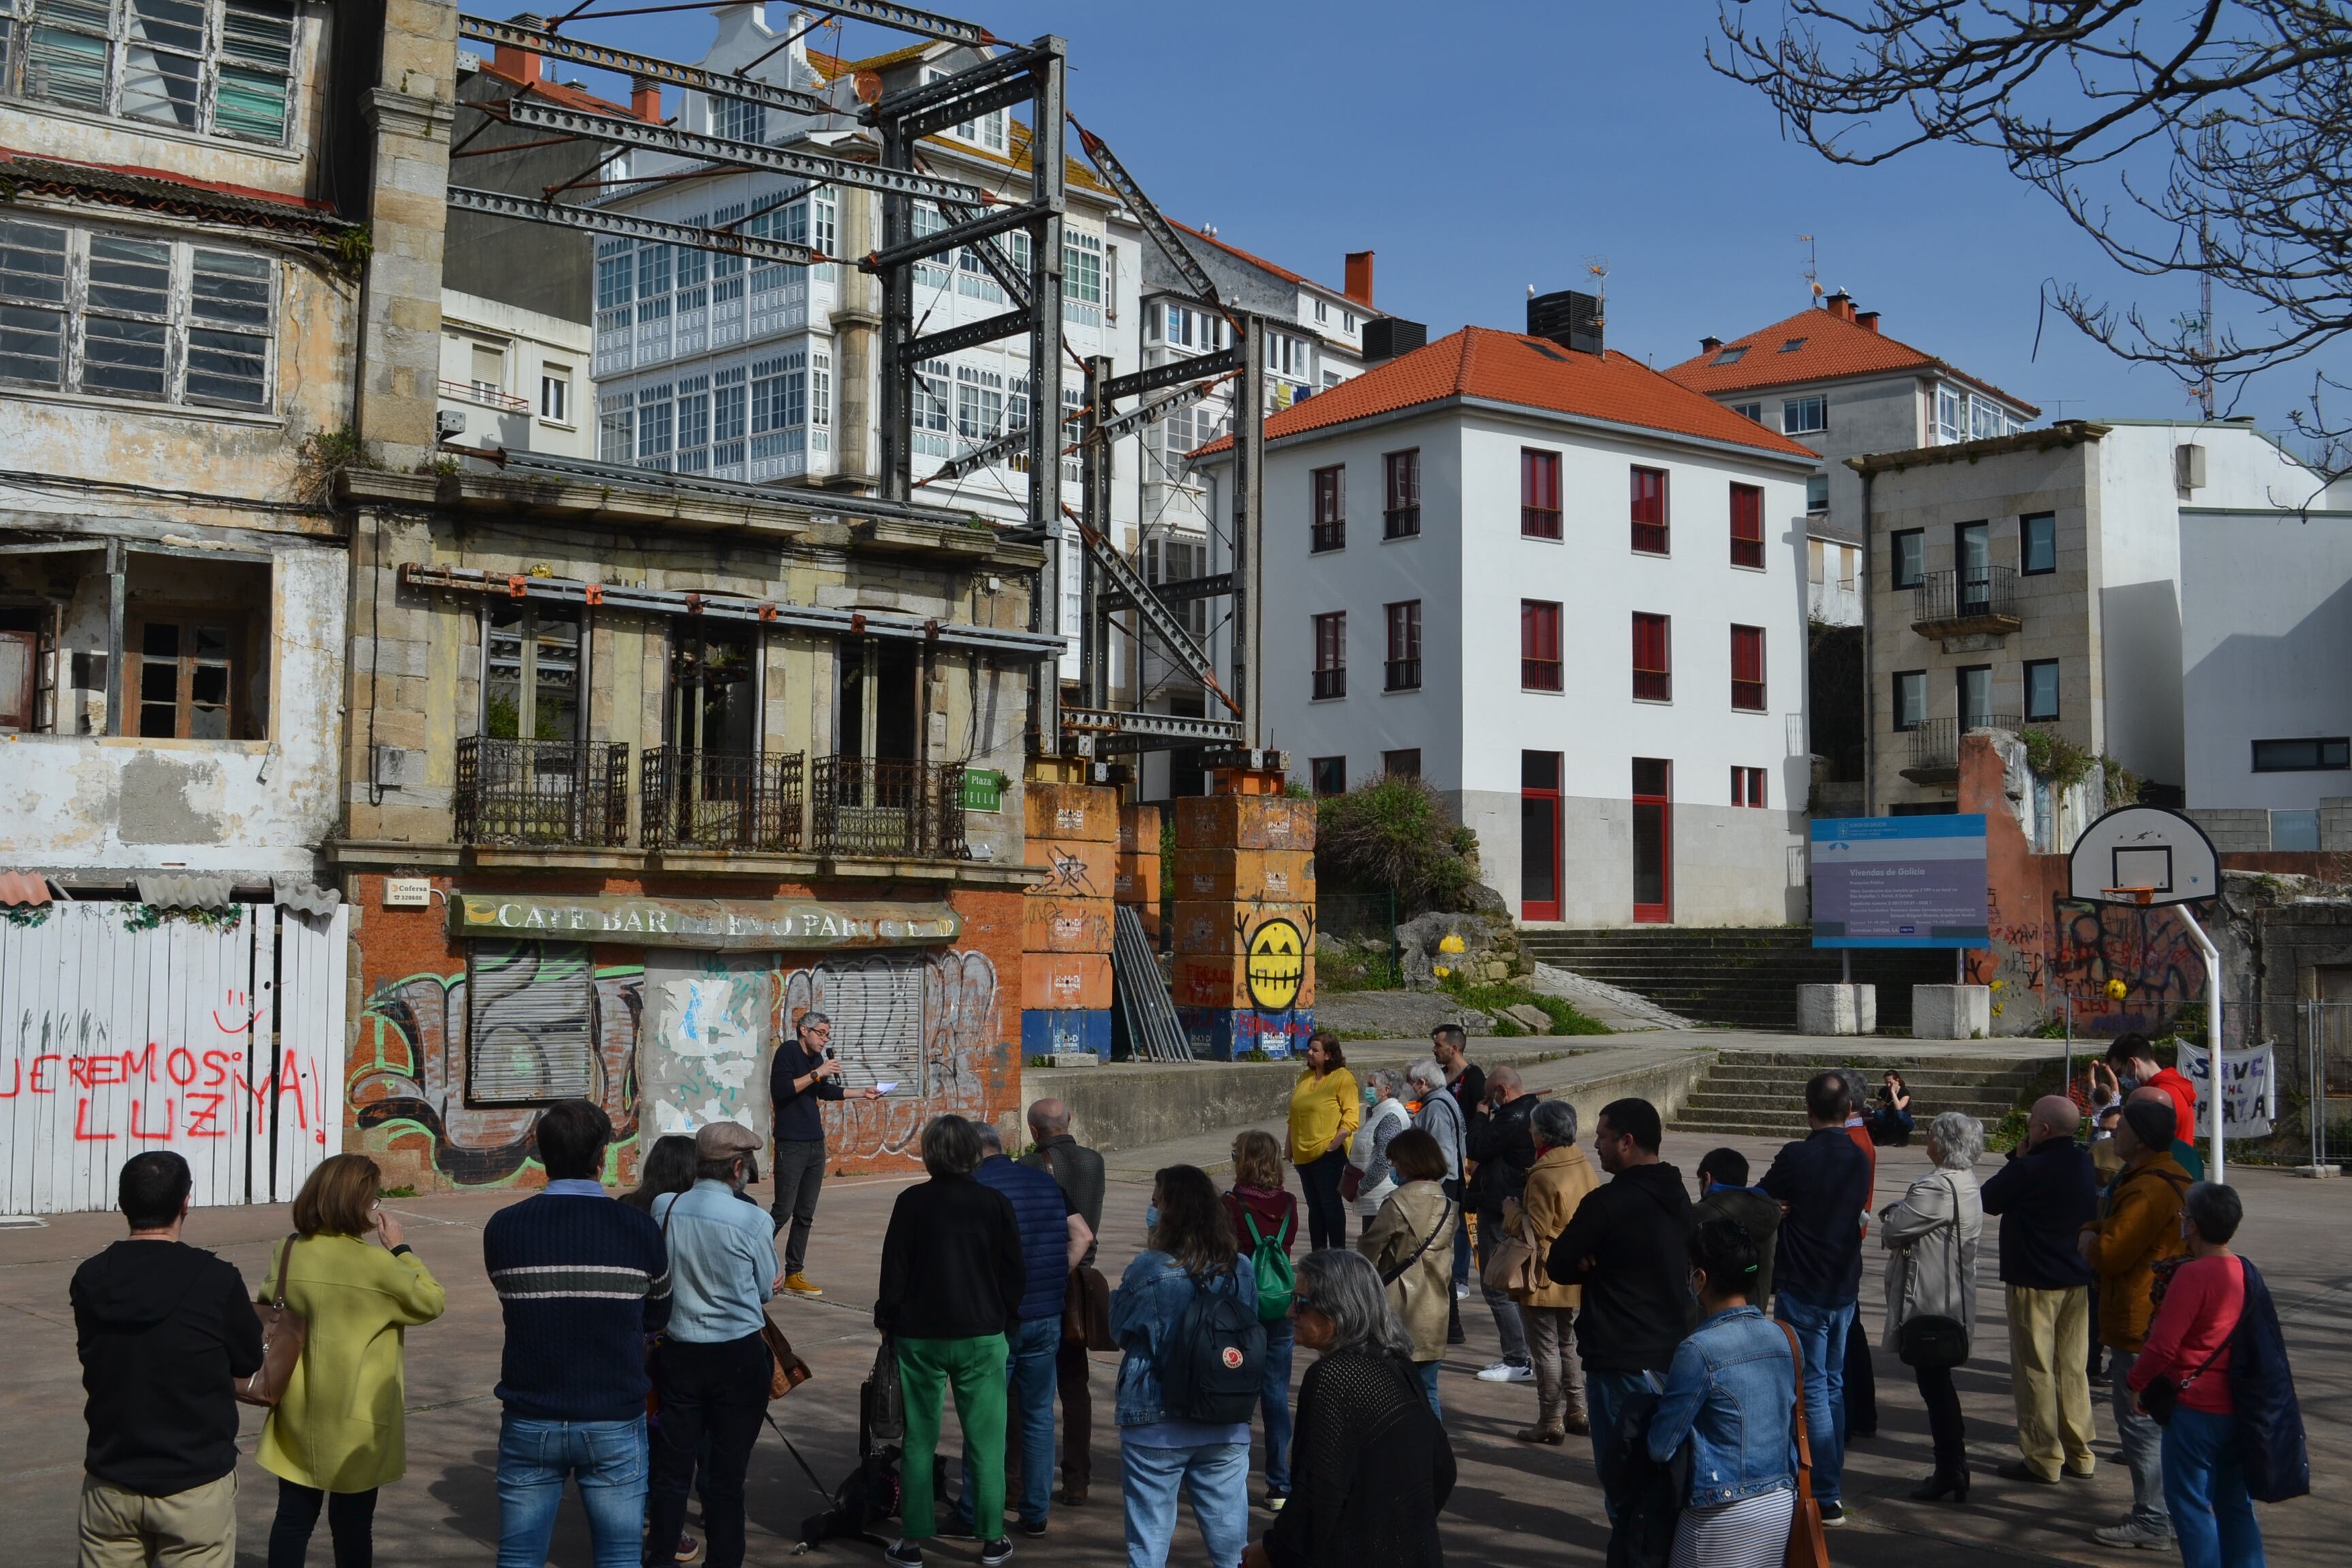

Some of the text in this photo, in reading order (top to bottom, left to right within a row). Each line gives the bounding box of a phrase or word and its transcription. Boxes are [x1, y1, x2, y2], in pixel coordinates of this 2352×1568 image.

[971, 775, 992, 786] Plaza
[1898, 868, 1925, 876] Galicia
[603, 909, 669, 933] BAR
[75, 1092, 227, 1141] LUZ
